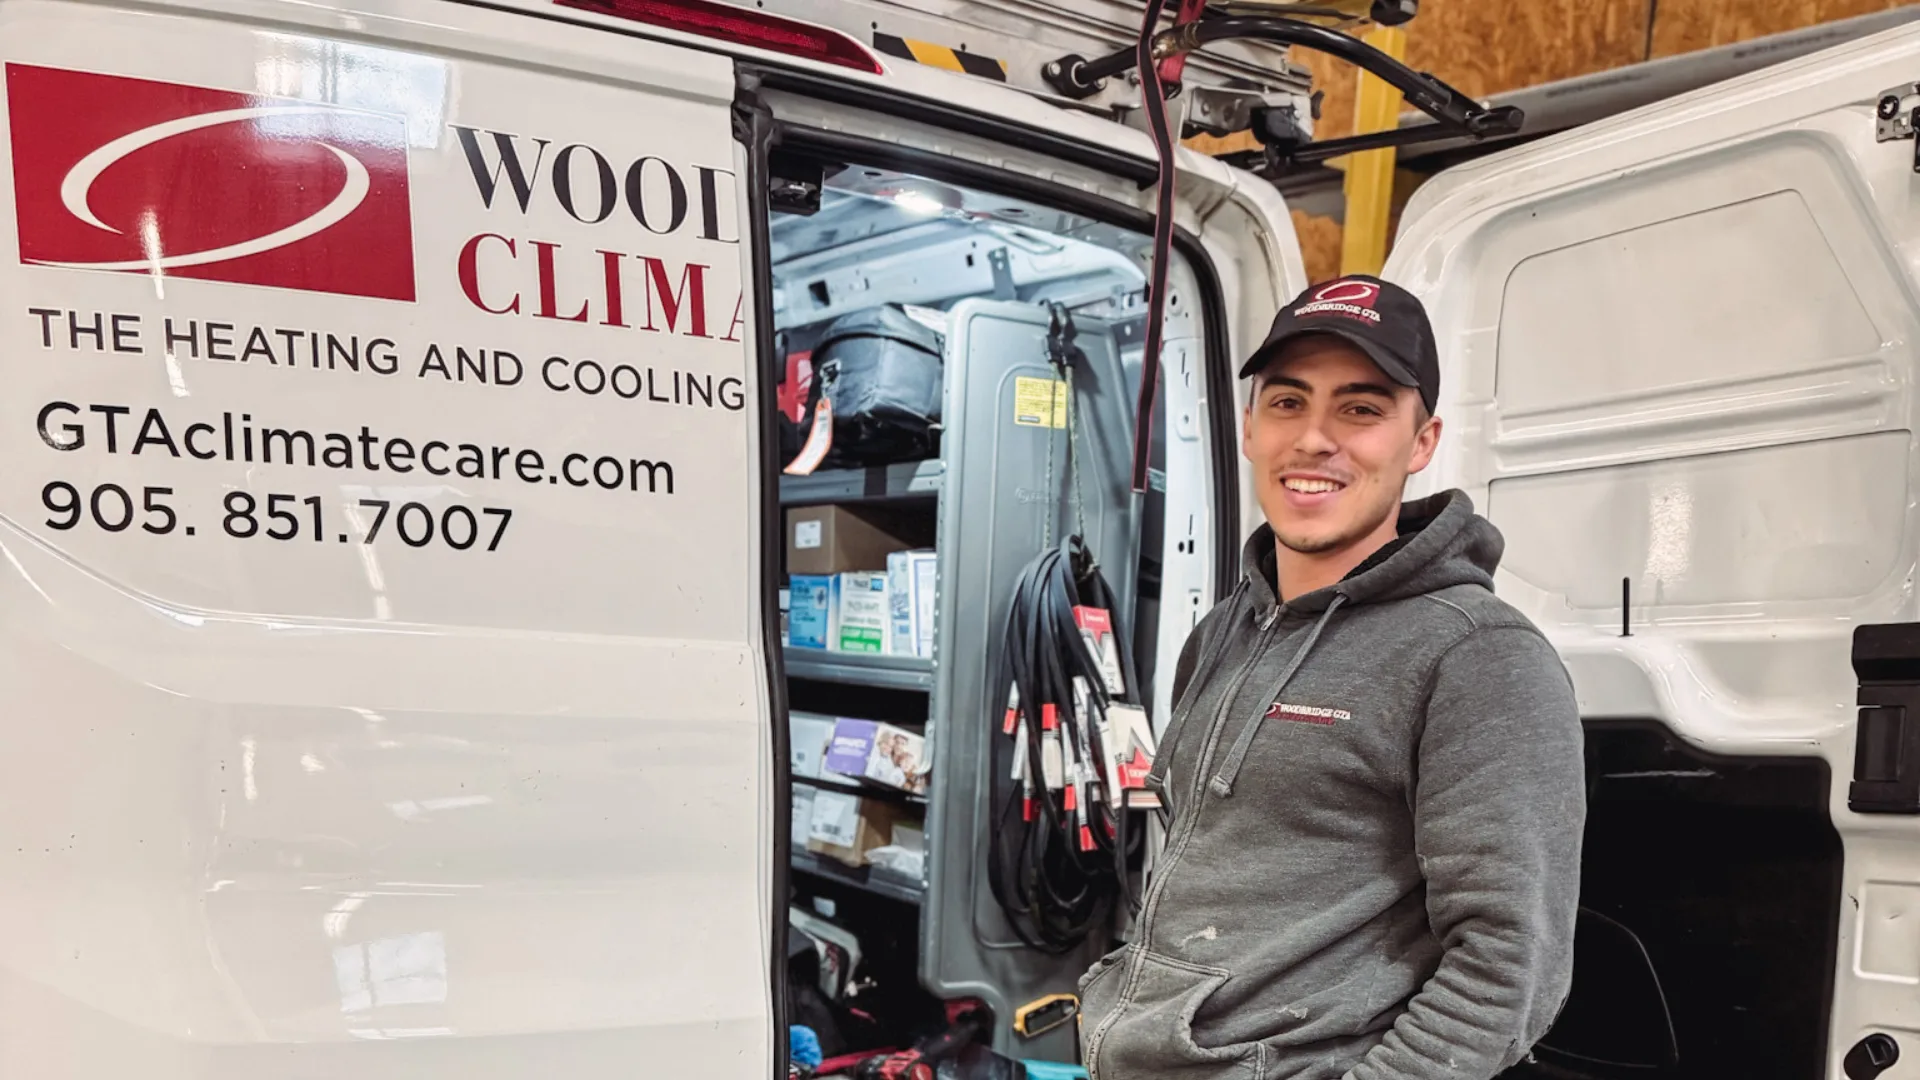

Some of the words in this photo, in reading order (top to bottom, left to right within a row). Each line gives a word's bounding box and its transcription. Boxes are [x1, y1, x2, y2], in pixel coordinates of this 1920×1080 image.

[1294, 303, 1361, 316] WOODBRIDGE
[1361, 308, 1381, 322] GTA
[28, 307, 143, 354] THE
[164, 318, 399, 375] HEATING
[418, 343, 524, 386] AND
[541, 356, 745, 411] COOLING
[36, 401, 674, 494] GTAclimatecare.com
[41, 480, 197, 538] 905.
[222, 490, 513, 552] 851.7007
